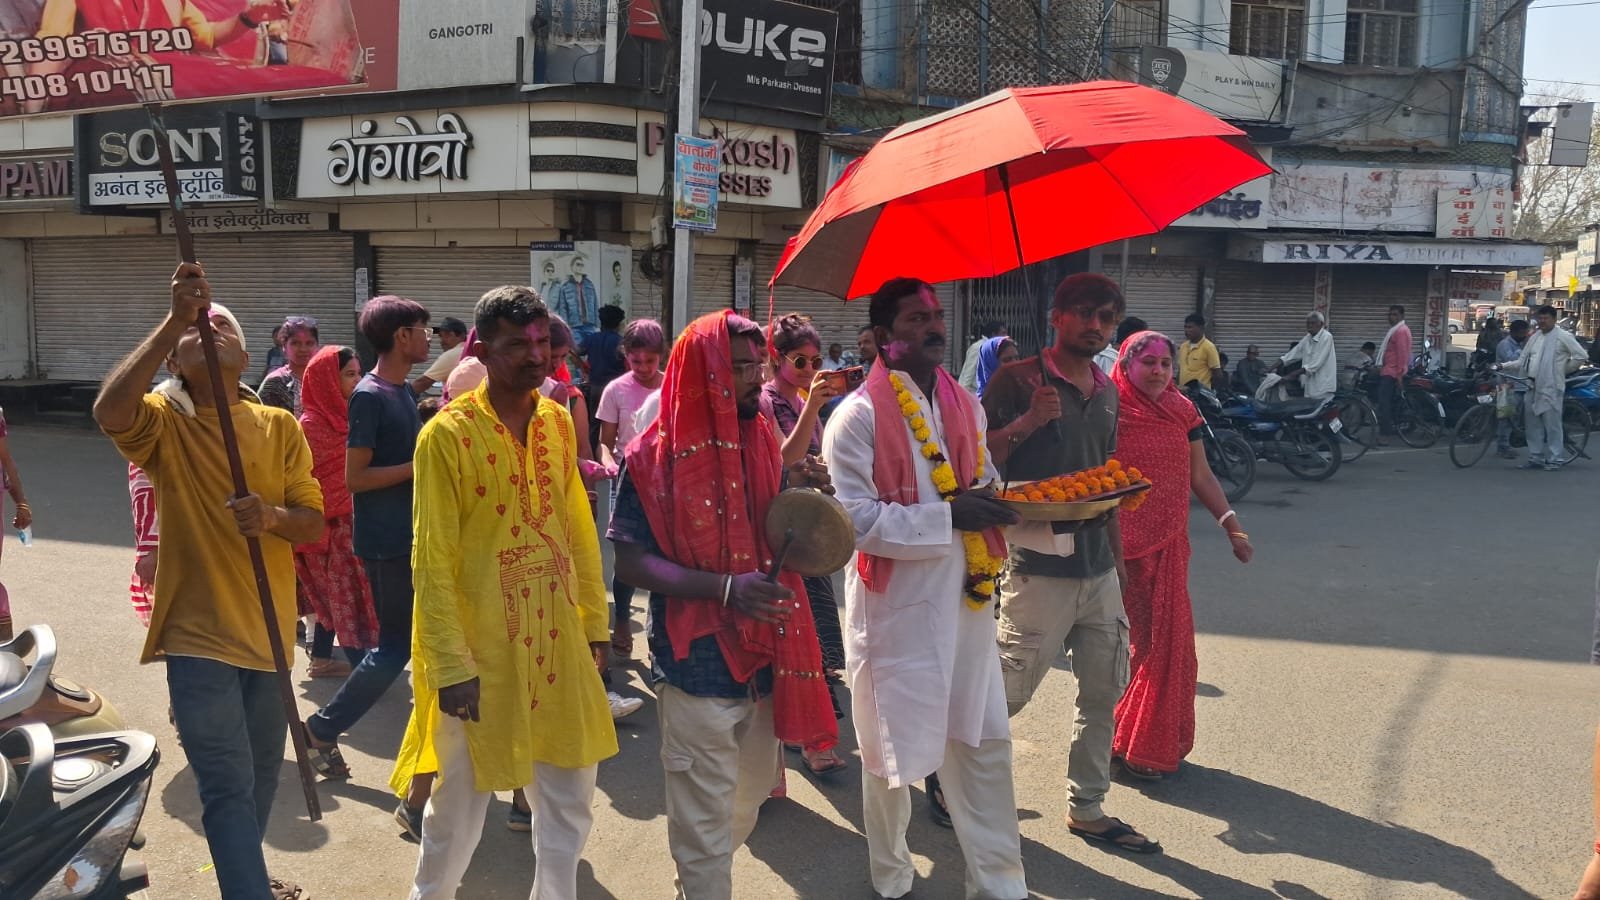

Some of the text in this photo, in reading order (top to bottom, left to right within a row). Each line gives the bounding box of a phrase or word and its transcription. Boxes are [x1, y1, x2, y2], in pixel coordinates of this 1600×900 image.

[428, 23, 494, 40] GANGOTRI
[761, 76, 792, 90] Parkash
[793, 81, 822, 95] Dresses
[1214, 75, 1234, 85] PLAY
[1241, 78, 1255, 88] WIN
[1255, 80, 1276, 89] DAILY
[238, 116, 257, 193] SONY
[327, 112, 474, 185] गंगोत्री
[94, 175, 140, 198] अनंत
[1284, 243, 1393, 261] RIYA
